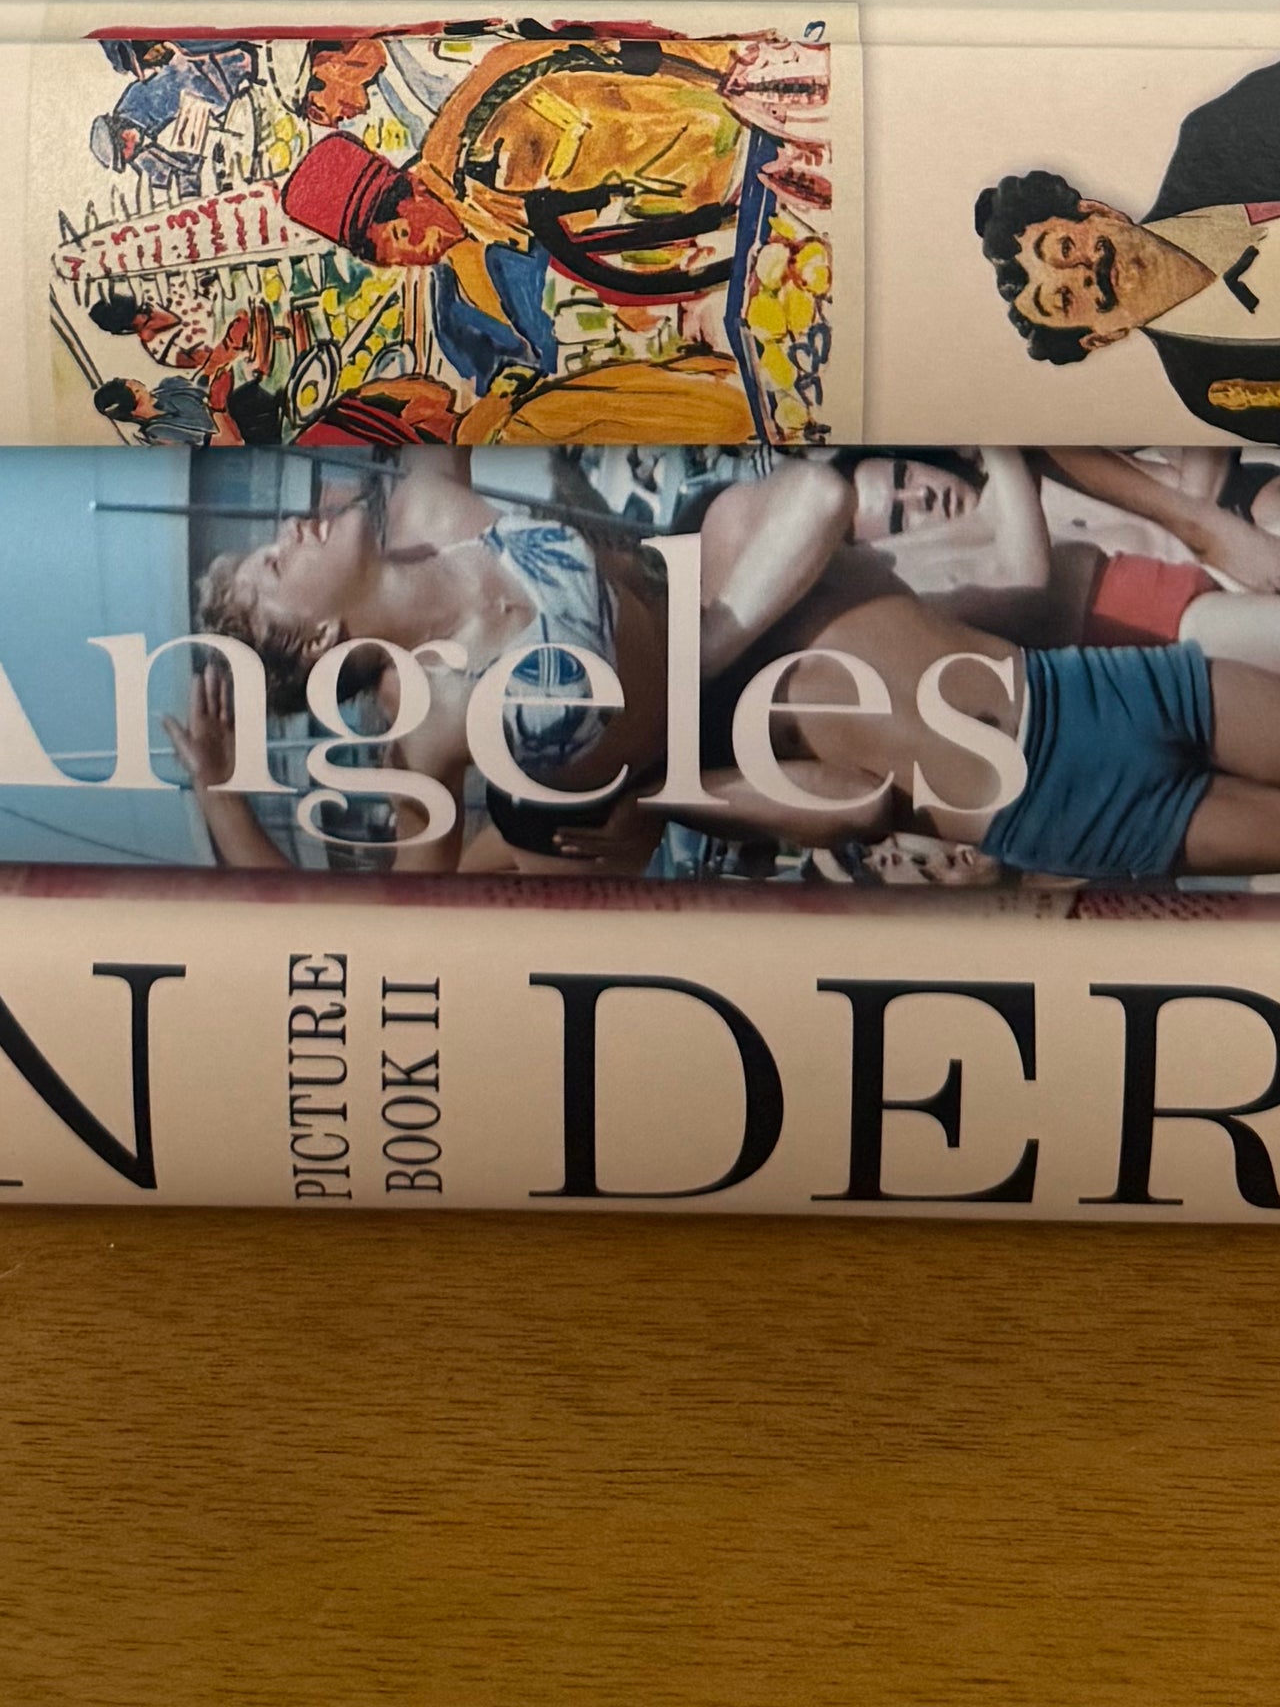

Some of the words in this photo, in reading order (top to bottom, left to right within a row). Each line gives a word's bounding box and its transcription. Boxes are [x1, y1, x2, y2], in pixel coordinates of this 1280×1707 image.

[381, 976, 440, 1029] II
[288, 954, 352, 1199] PICTURE
[381, 1049, 442, 1193] BOOK
